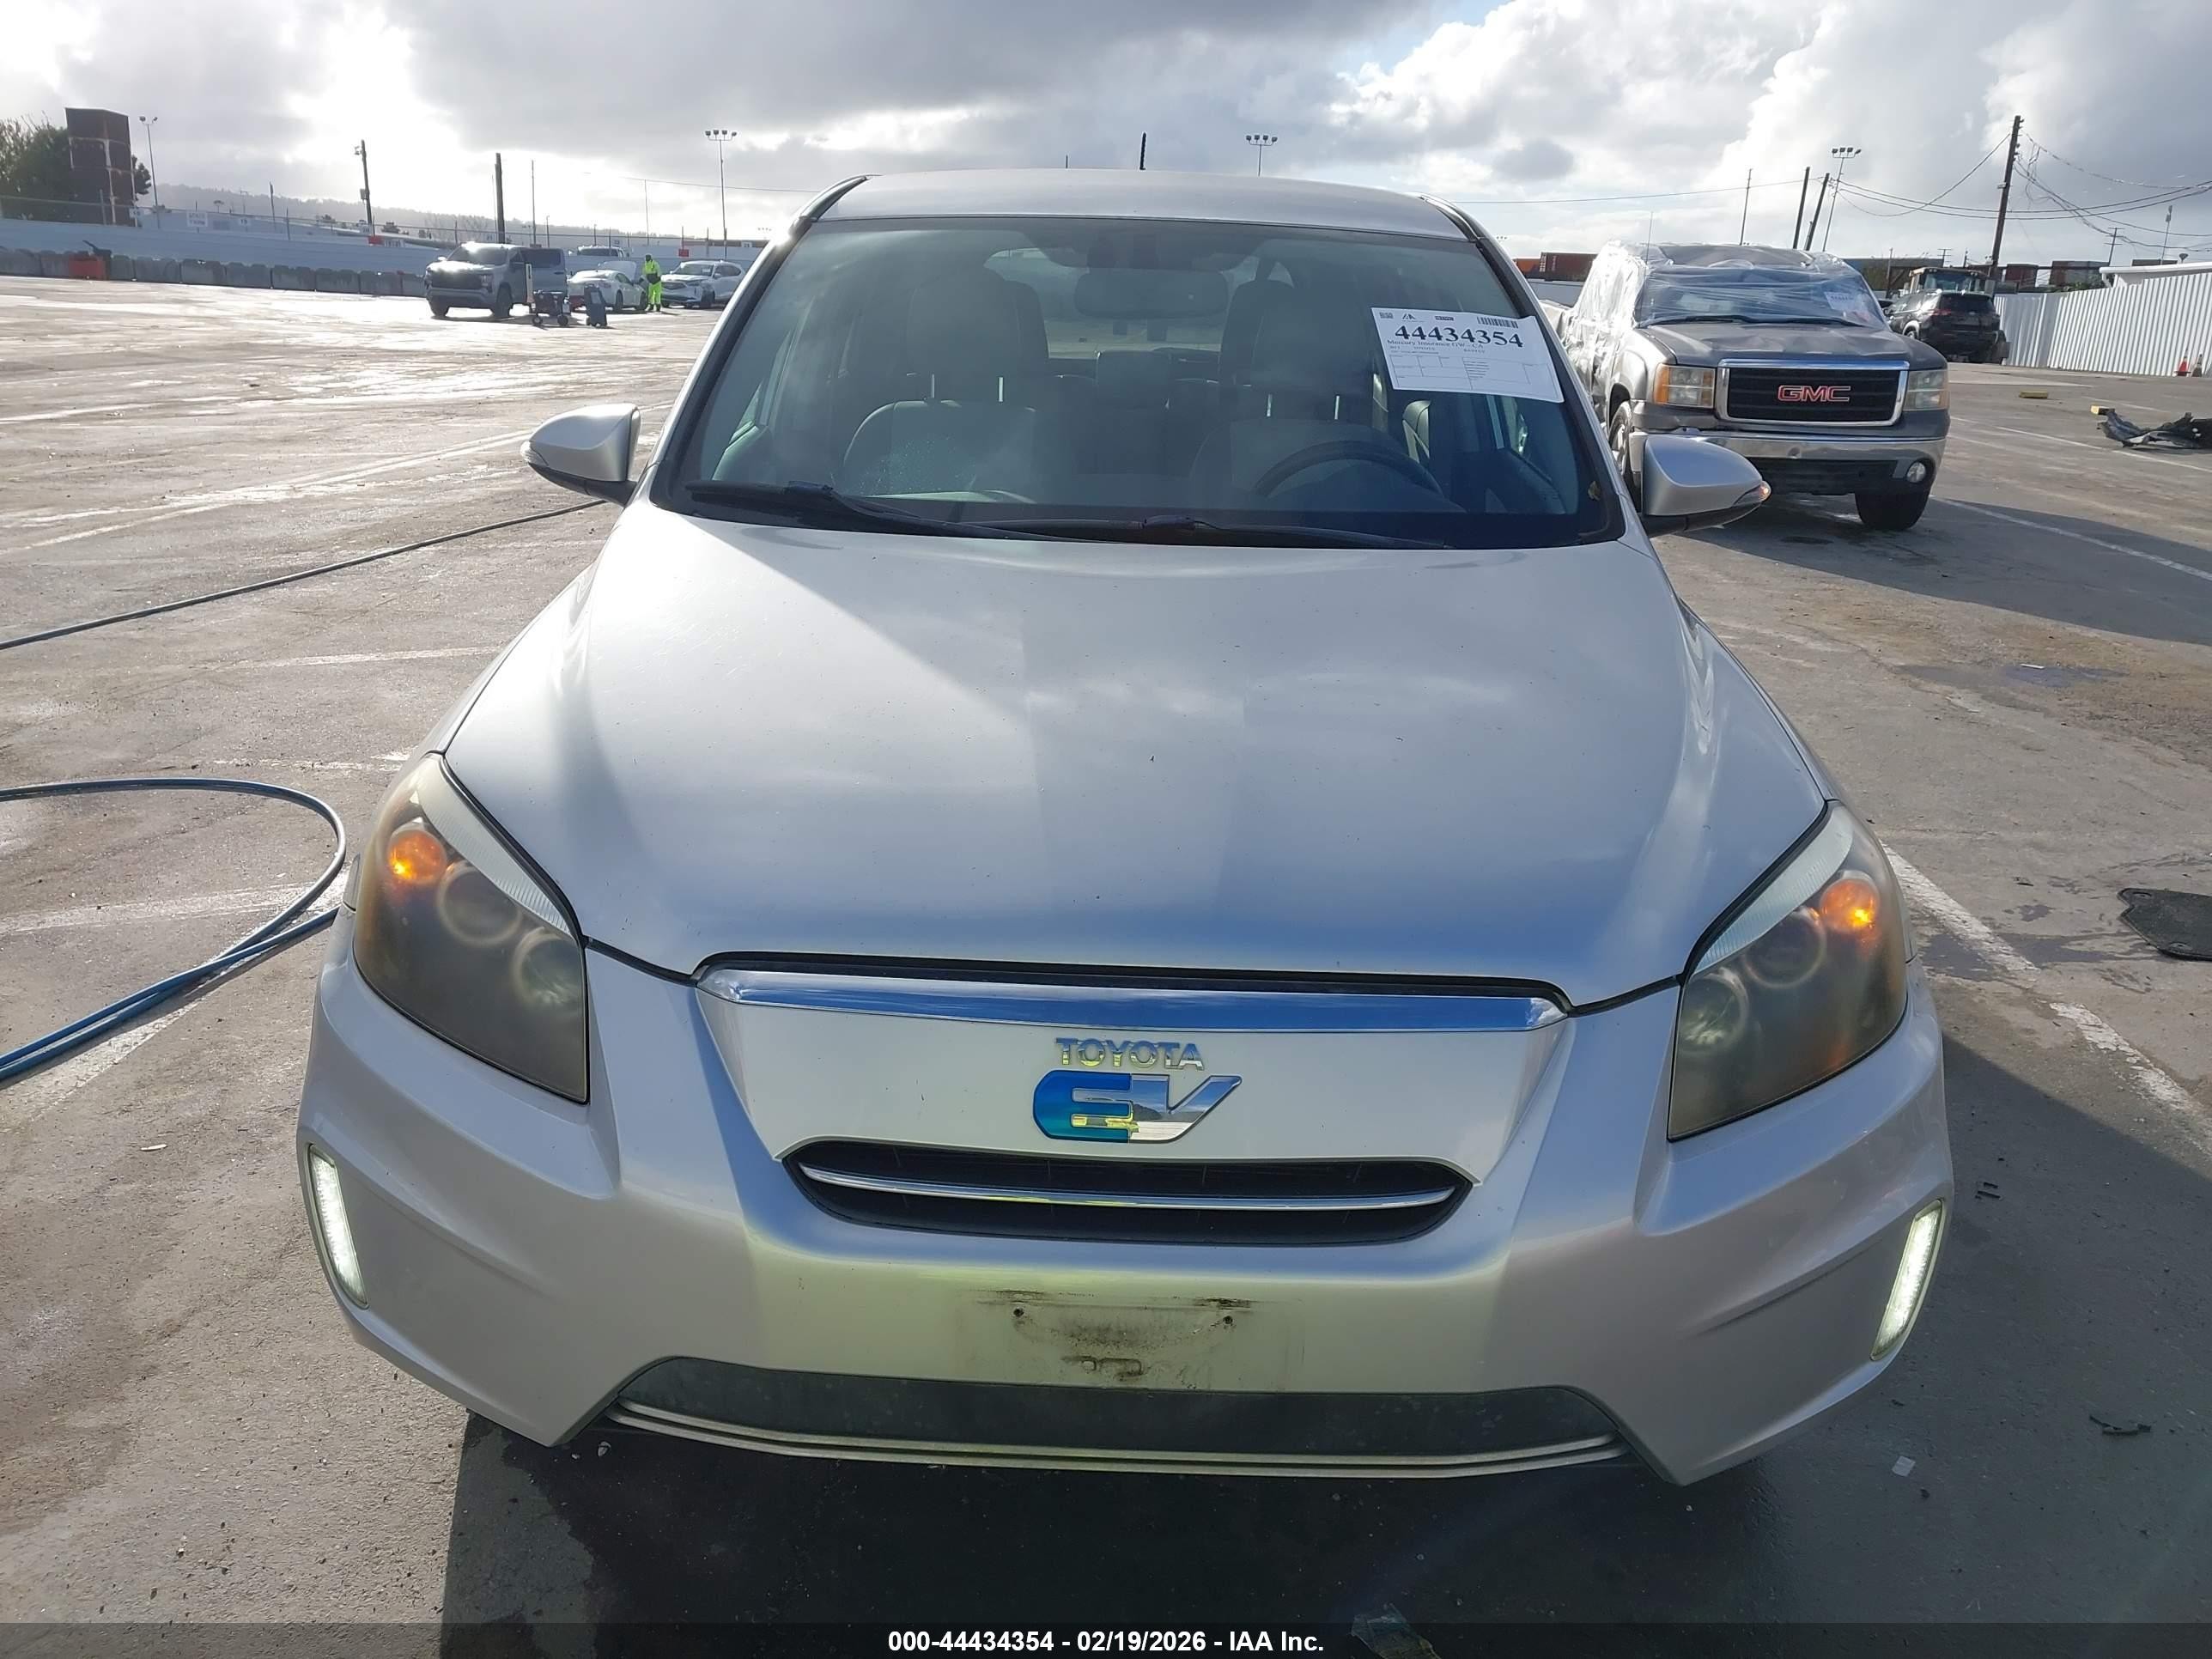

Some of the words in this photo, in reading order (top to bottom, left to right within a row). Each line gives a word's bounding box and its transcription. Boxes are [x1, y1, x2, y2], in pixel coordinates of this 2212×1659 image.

[1387, 338, 1416, 347] Mercury
[1395, 325, 1524, 348] 44434354
[1778, 385, 1851, 403] GMC
[1055, 1037, 1205, 1071] TOYOTA
[1033, 1069, 1243, 1144] EV
